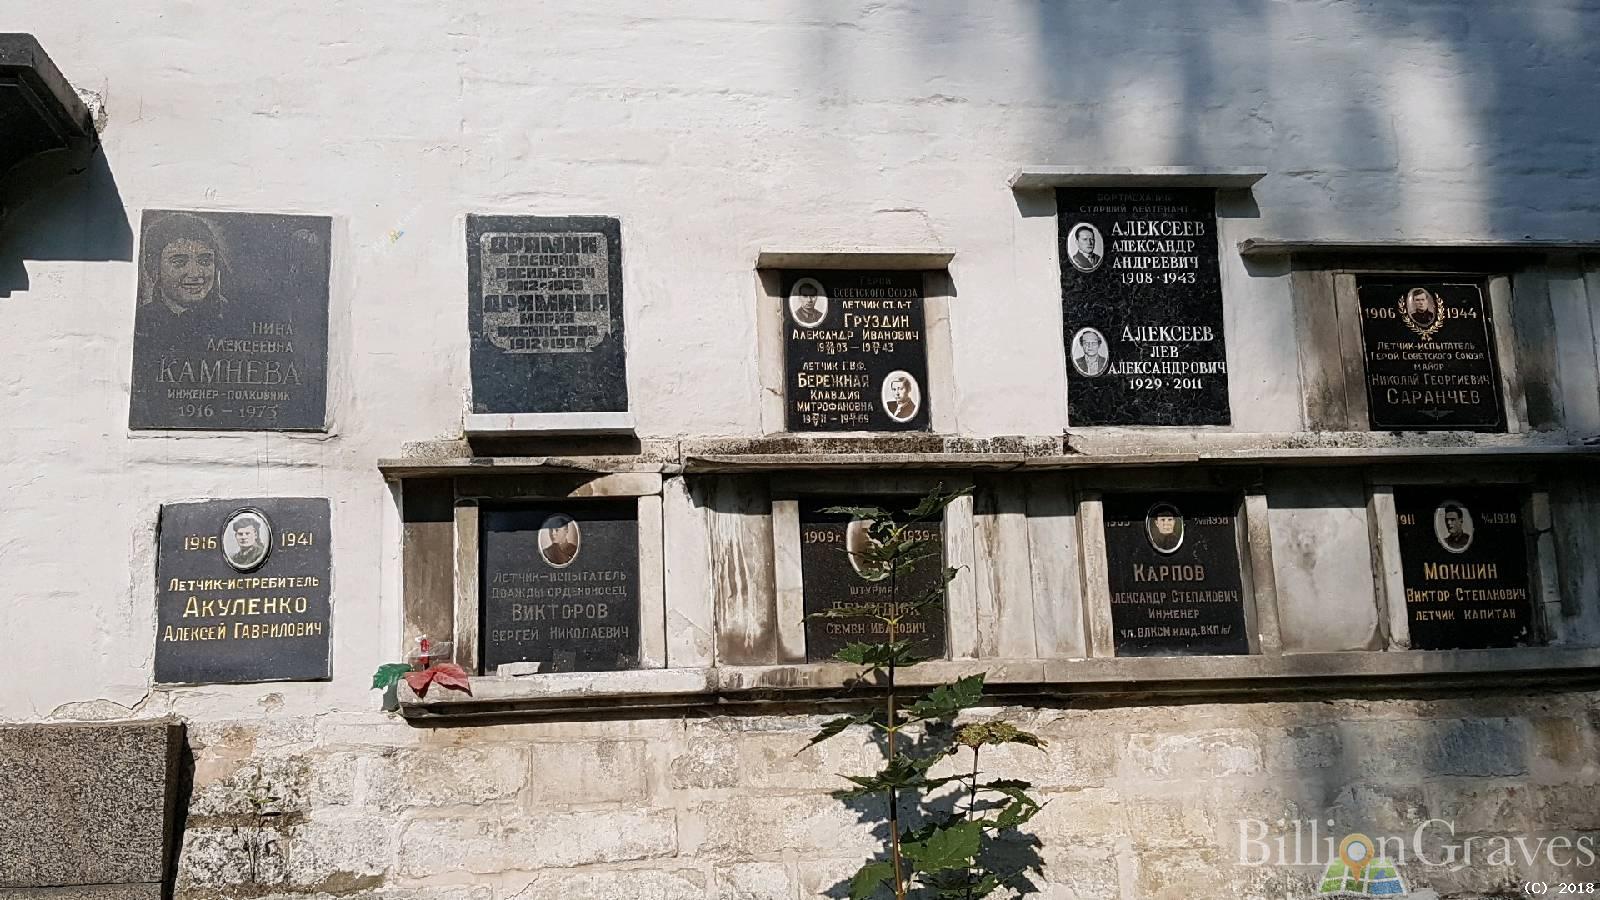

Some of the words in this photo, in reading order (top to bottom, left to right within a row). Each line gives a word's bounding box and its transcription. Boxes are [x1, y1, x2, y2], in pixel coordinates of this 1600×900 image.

[1111, 221, 1205, 237] АЛЕКСЕЕВ
[1111, 239, 1195, 253] АЛЕКСАНДР
[1112, 256, 1199, 269] АНДРЕЕВИЧ
[1120, 272, 1153, 284] 1908
[1163, 272, 1196, 284] 1943
[842, 300, 879, 309] ЛЕТЧИК
[1365, 307, 1396, 319] 1906
[1446, 307, 1477, 319] 1944
[844, 313, 910, 328] ГРУЗДИН
[252, 320, 293, 336] НИНА
[792, 329, 854, 341] АЛЕКСАНДР
[862, 329, 919, 341] ИВАНОВИЧ
[1120, 326, 1214, 342] АЛЕКСЕЕВ
[207, 338, 294, 353] АЛЕКСЕЕВНА
[1150, 345, 1179, 358] ЛЕВ
[1377, 341, 1475, 351] ЛЕТЧИК-ИСПЫТАТЕЛЬ
[1370, 351, 1400, 361] ГЕРОЙ
[1402, 351, 1453, 360] СОВЕТСКОГО
[1455, 351, 1485, 360] СОЮЗА
[157, 356, 303, 385] КАМНЕВА
[802, 361, 839, 371] ЛЕТЧИК
[1107, 361, 1227, 375] АЛЕКСАНДРОВИЧ
[1413, 362, 1444, 371] МАЙОР
[797, 372, 870, 388] БЕРЕЖНАЯ
[1129, 378, 1162, 390] 1929
[1173, 378, 1204, 390] 2011
[1371, 374, 1420, 386] НИКОЛАЙ
[1423, 373, 1490, 386] ГЕОРГИЕВИЧ
[810, 389, 860, 401] КЛАВДИЯ
[1387, 388, 1481, 405] САРАНЧЕВ
[178, 404, 214, 418] 1916
[796, 401, 874, 412] МИТРОФАНОВНА
[184, 536, 217, 551] 1916
[281, 532, 313, 547] 1941
[1133, 563, 1205, 582] КАРПОВ
[1424, 562, 1498, 580] МОКШИН
[168, 577, 320, 592] ЛЕТЧИК-ИСТРЕБИТЕЛЬ
[492, 587, 544, 599] ДВАЖДЫ
[547, 586, 628, 599] ОРДЕНОНОСЕЦ
[1171, 590, 1238, 602] СТЕПАНОВИЧ
[1407, 588, 1450, 603] ВИКТОР
[1455, 587, 1526, 601] СТЕПАНОВИЧ
[182, 595, 307, 618] АКУЛЕНКО
[512, 603, 608, 621] ВИКТОРОВ
[1148, 608, 1200, 619] ИНЖЕНЕР
[1416, 610, 1455, 621] ЛЕТЧИК
[1464, 609, 1516, 620] КАПИТАН
[163, 622, 227, 642] АЛЕКСЕЙ
[234, 621, 322, 640] ГАВРИЛОВИЧ
[492, 627, 539, 642] СЕРГЕЙ
[550, 626, 629, 640] НИКОЛАЕВИЧ
[826, 622, 865, 634] СЕМЕН
